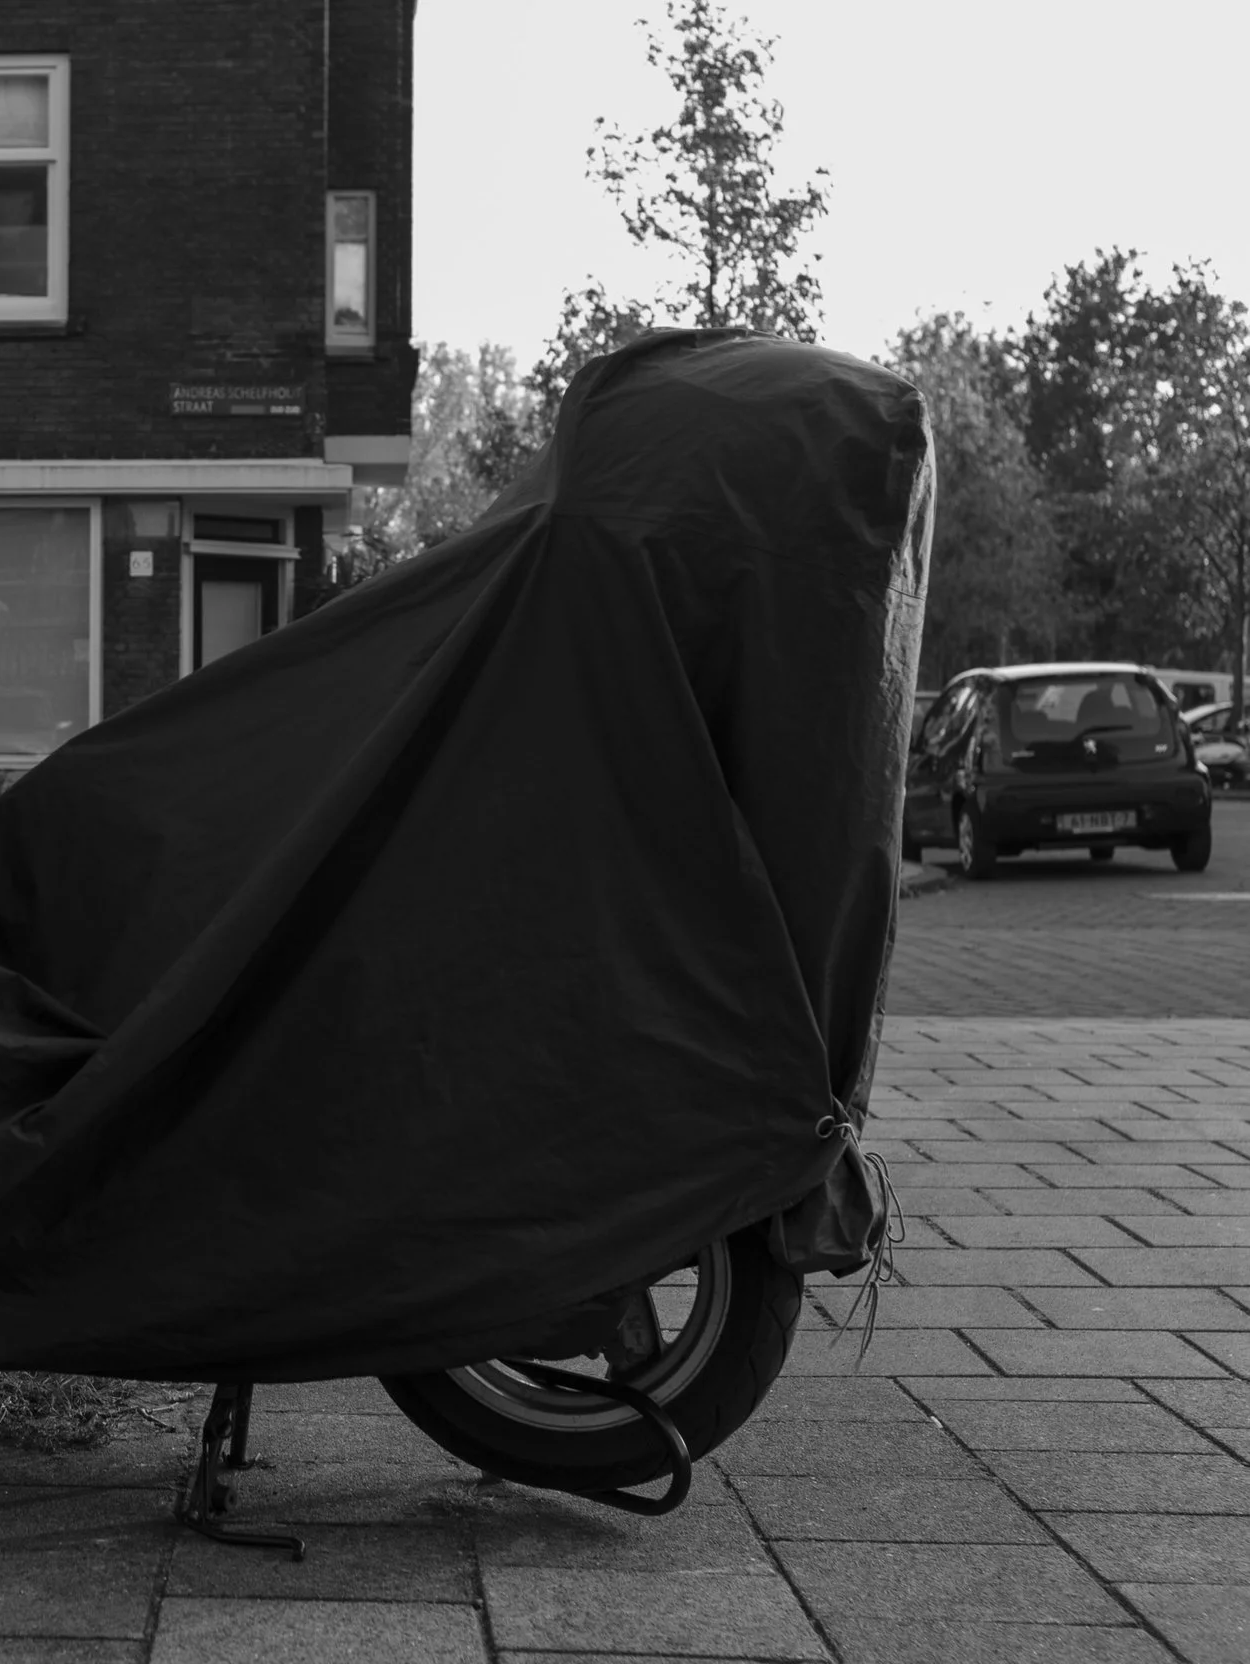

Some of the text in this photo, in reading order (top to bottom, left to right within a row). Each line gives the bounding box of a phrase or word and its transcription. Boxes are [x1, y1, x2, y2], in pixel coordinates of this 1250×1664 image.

[173, 386, 303, 400] ANDREAS SCHELFHOUT
[172, 400, 214, 413] STRAAT
